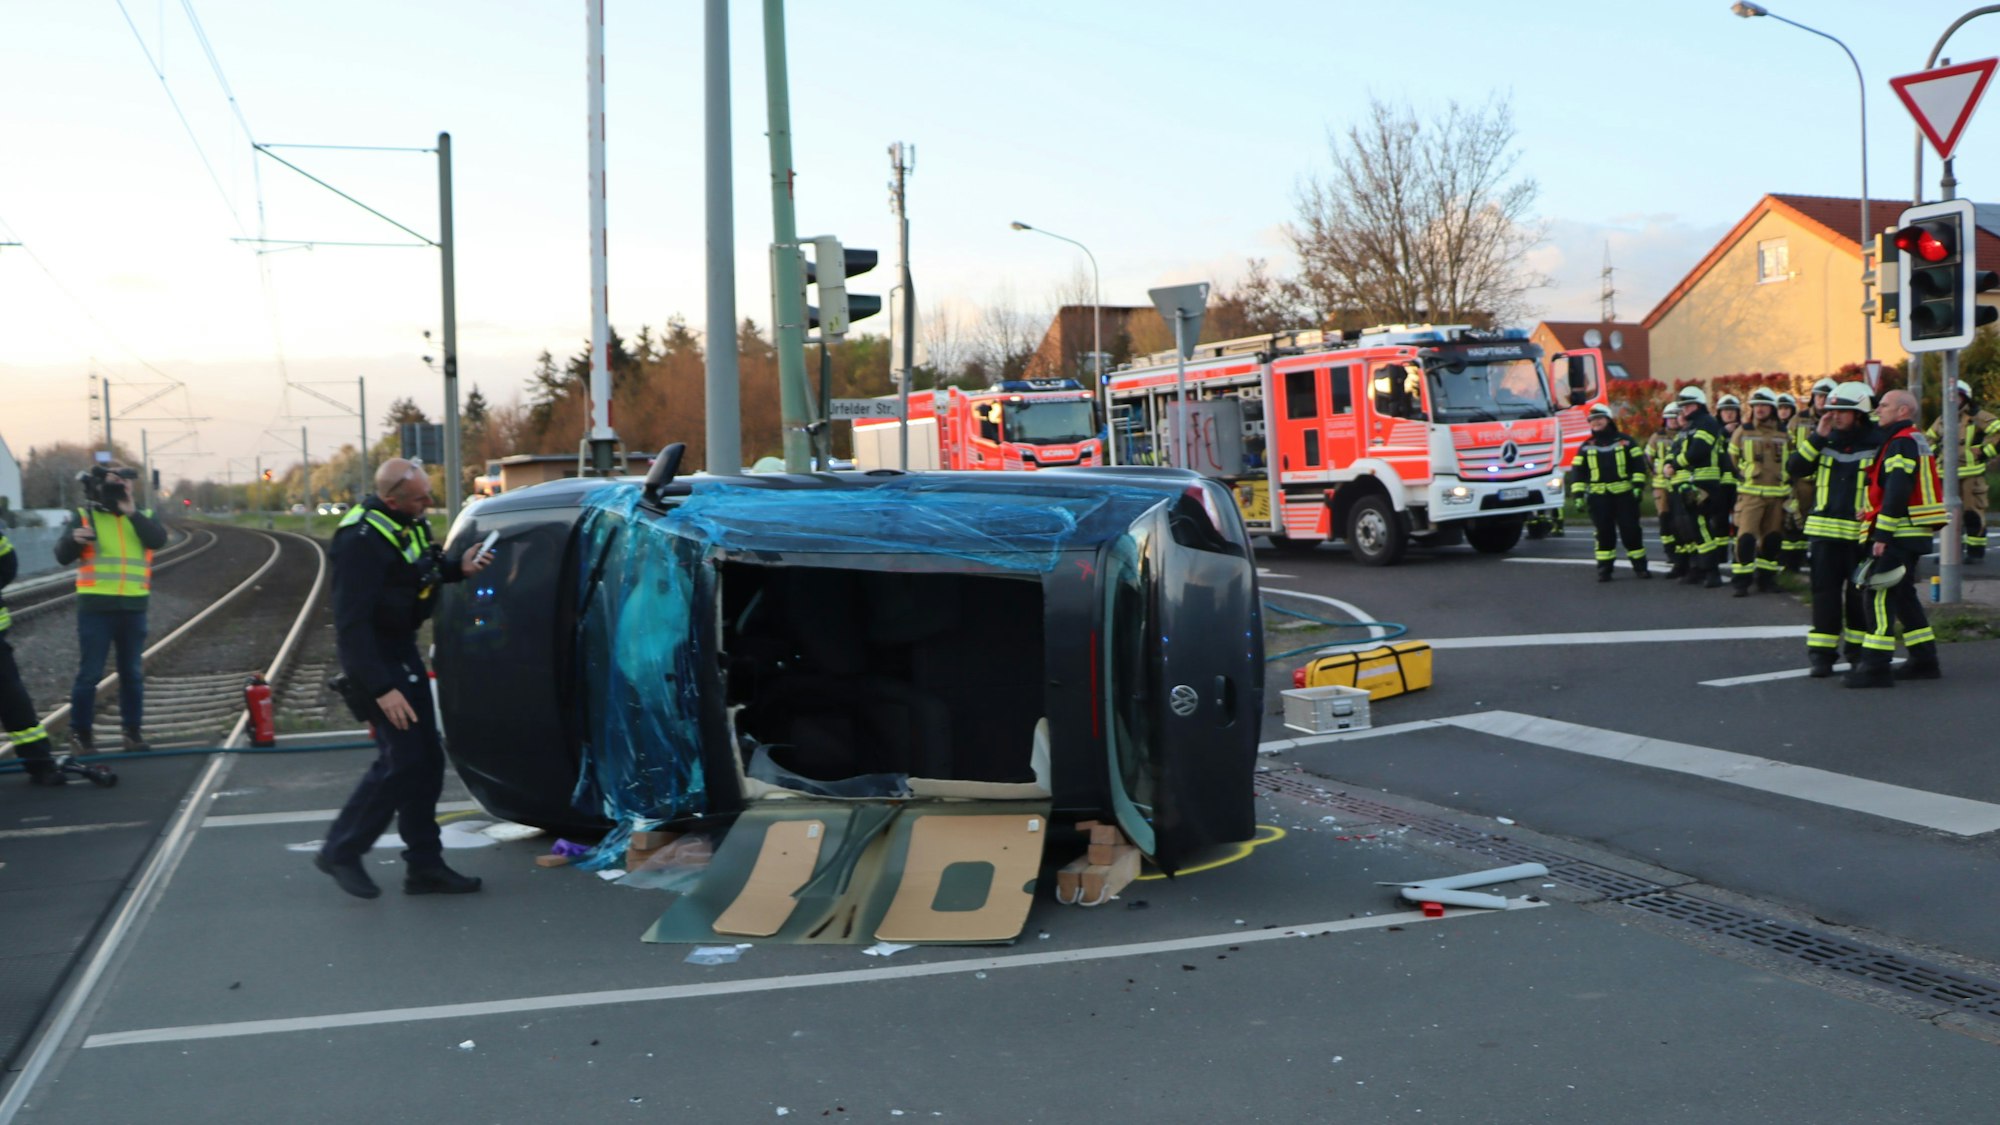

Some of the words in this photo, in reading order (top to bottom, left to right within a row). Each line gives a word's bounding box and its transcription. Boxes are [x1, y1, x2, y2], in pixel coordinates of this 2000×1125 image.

[1466, 346, 1522, 356] HAUPTWACHE
[876, 402, 895, 415] Str.
[1477, 428, 1537, 441] FEUERWEHR
[1042, 449, 1074, 457] SCANIA
